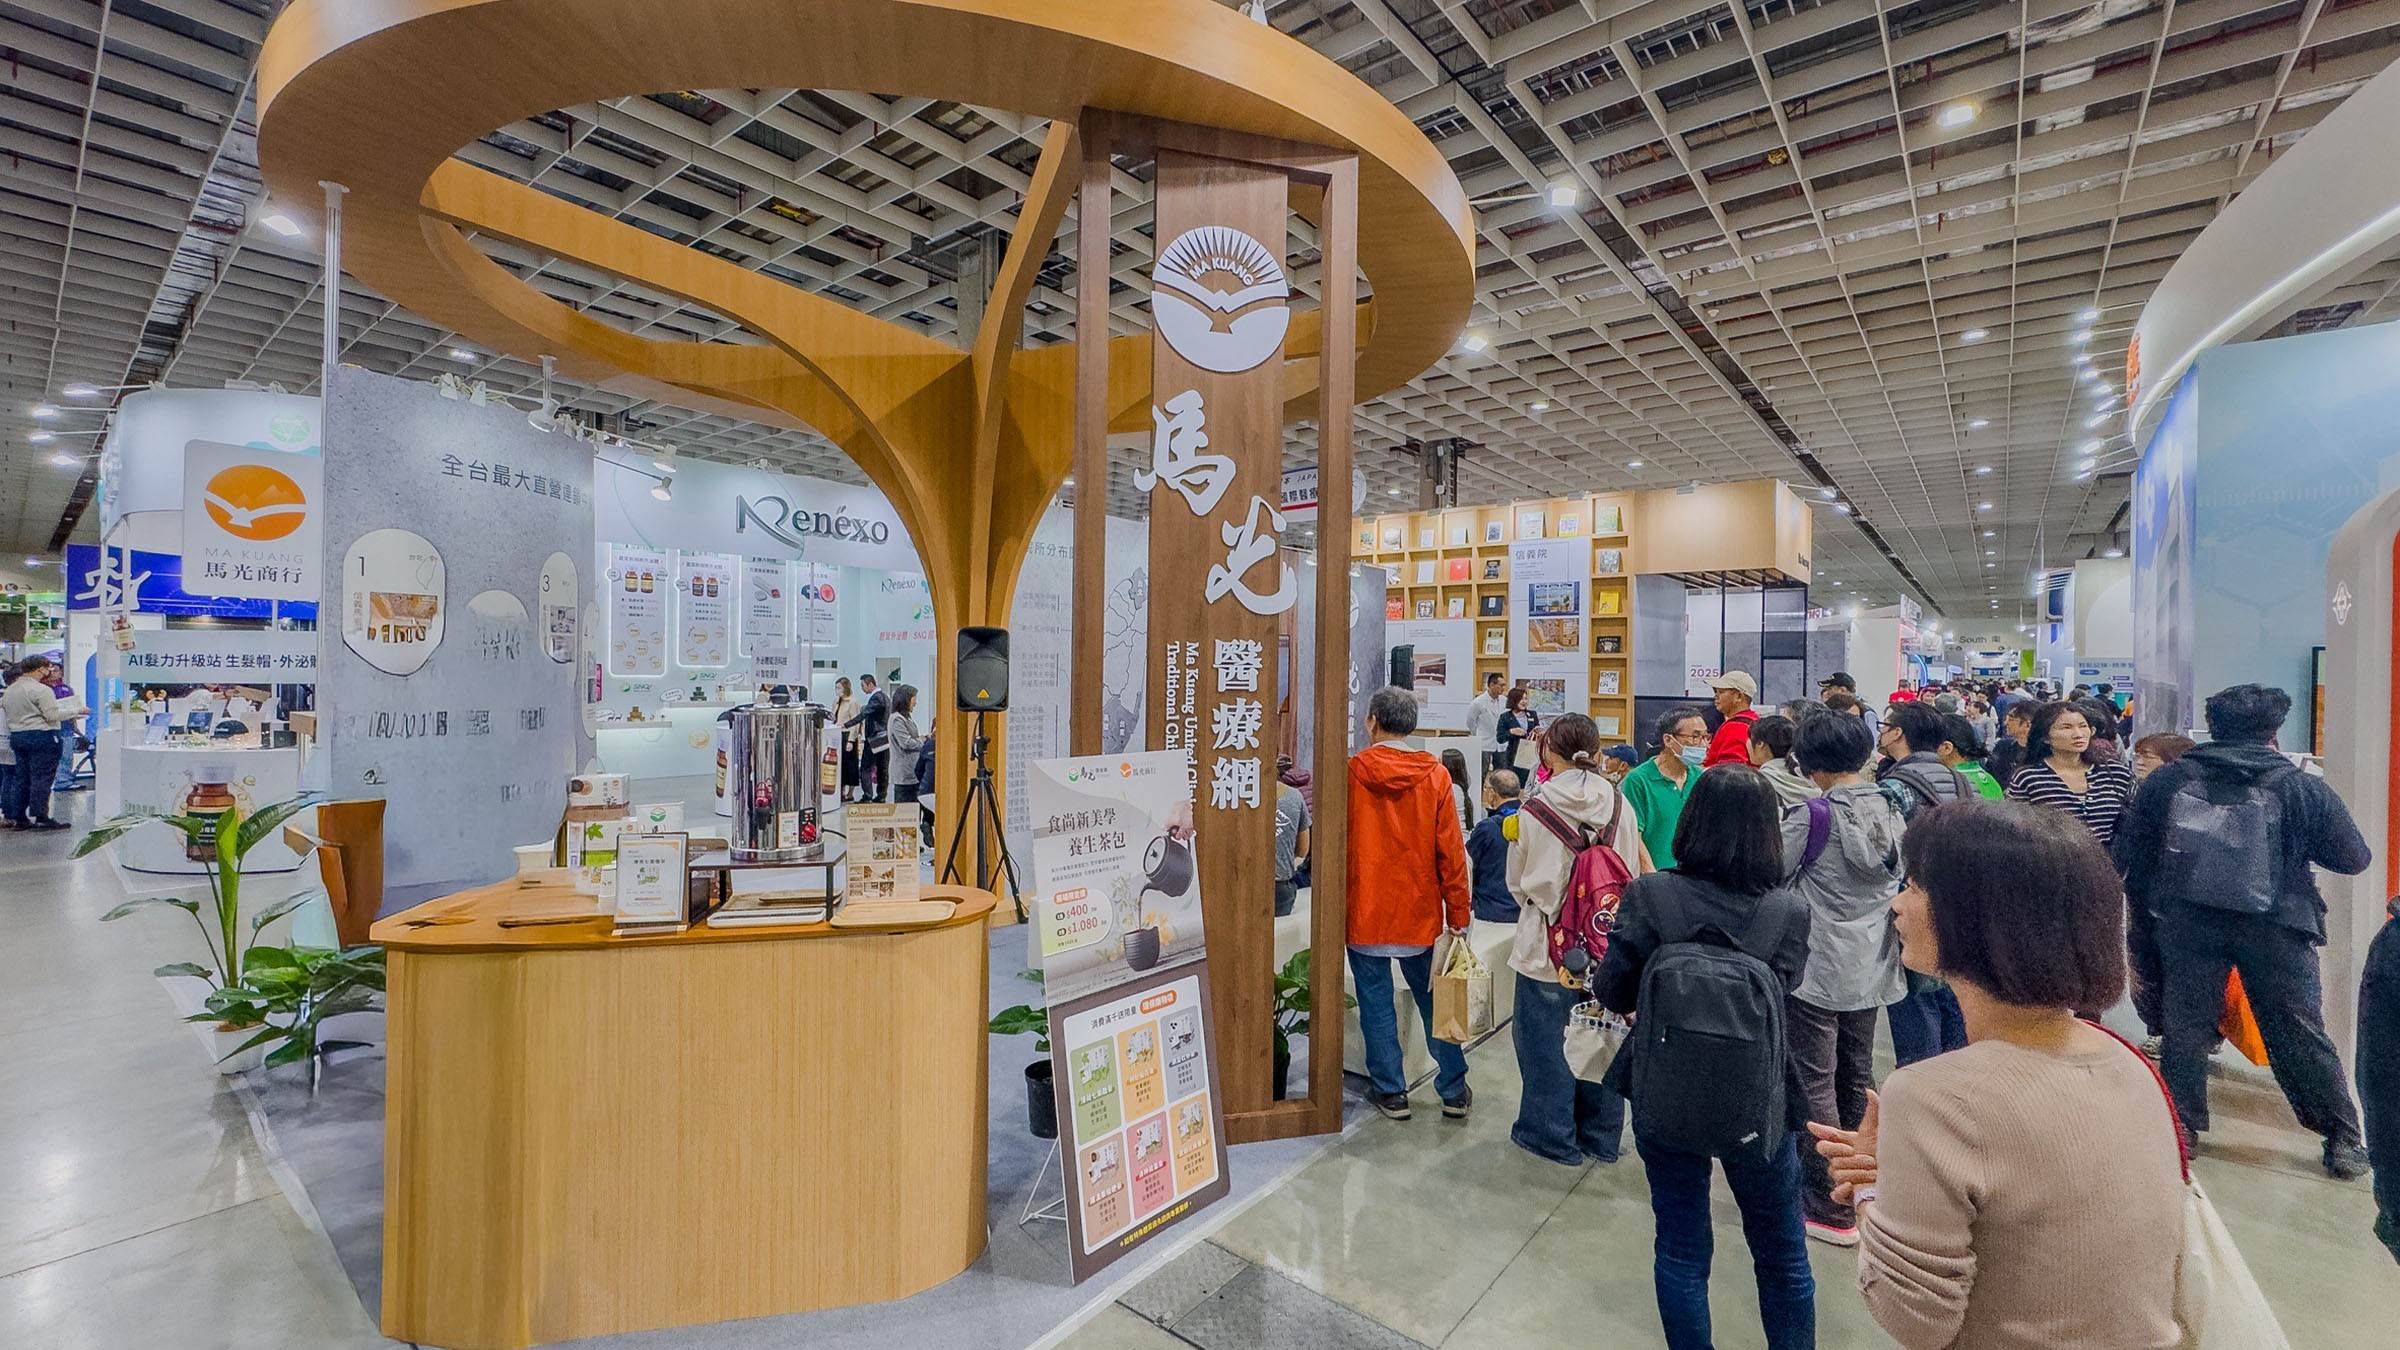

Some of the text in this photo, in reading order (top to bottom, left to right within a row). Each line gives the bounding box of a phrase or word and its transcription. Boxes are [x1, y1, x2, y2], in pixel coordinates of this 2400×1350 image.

[1189, 257, 1254, 287] MA KUANG
[736, 494, 889, 551] Renéxo
[204, 547, 305, 565] MA KUANG
[204, 561, 303, 585] 馬光商行
[1960, 635, 1988, 643] South
[1185, 641, 1200, 666] Ma
[1165, 640, 1180, 721] Traditional
[1690, 668, 1719, 678] 2025
[1181, 667, 1200, 715] Kuang
[1211, 638, 1263, 810] 醫療網
[1048, 807, 1116, 834] 食尚新美學
[1069, 831, 1126, 857] 養生茶包
[1066, 903, 1089, 920] $400
